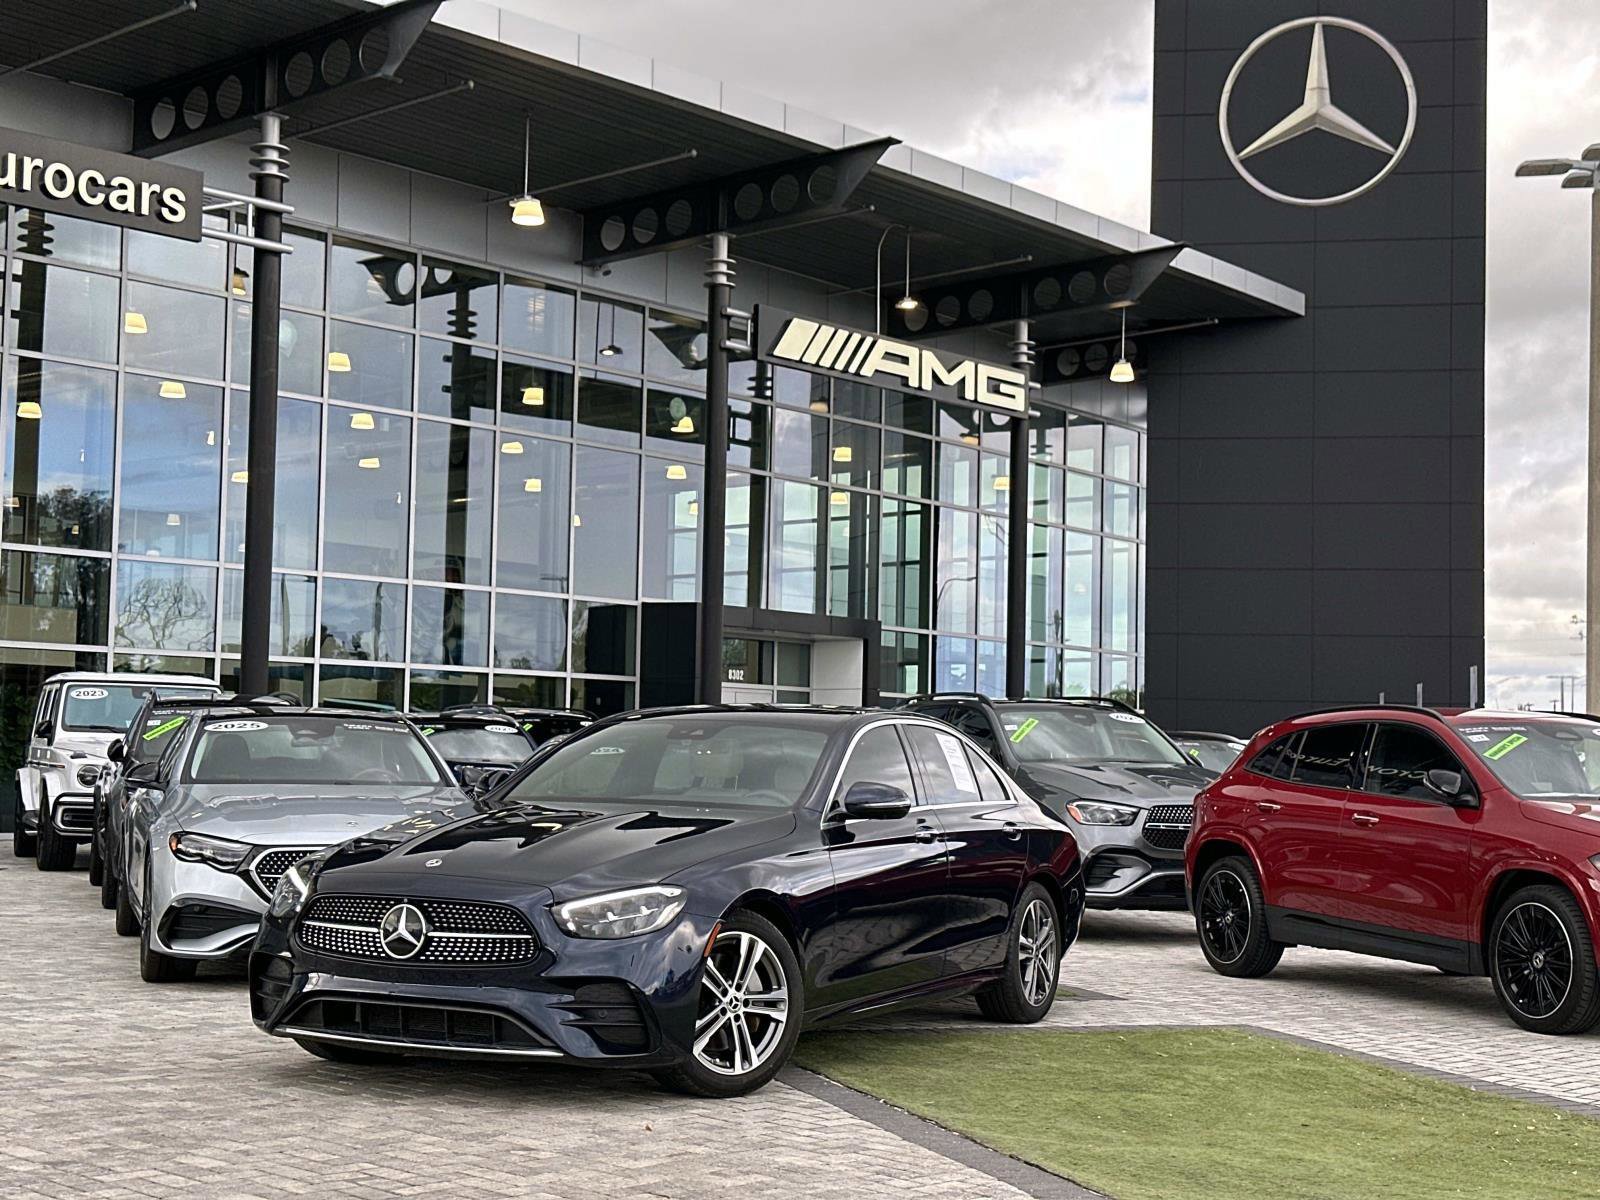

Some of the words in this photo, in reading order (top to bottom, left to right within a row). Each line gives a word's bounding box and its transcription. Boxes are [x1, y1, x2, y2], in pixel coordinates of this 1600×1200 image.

[860, 339, 1026, 412] AMG
[728, 669, 744, 681] 8302
[212, 722, 261, 730] 2025
